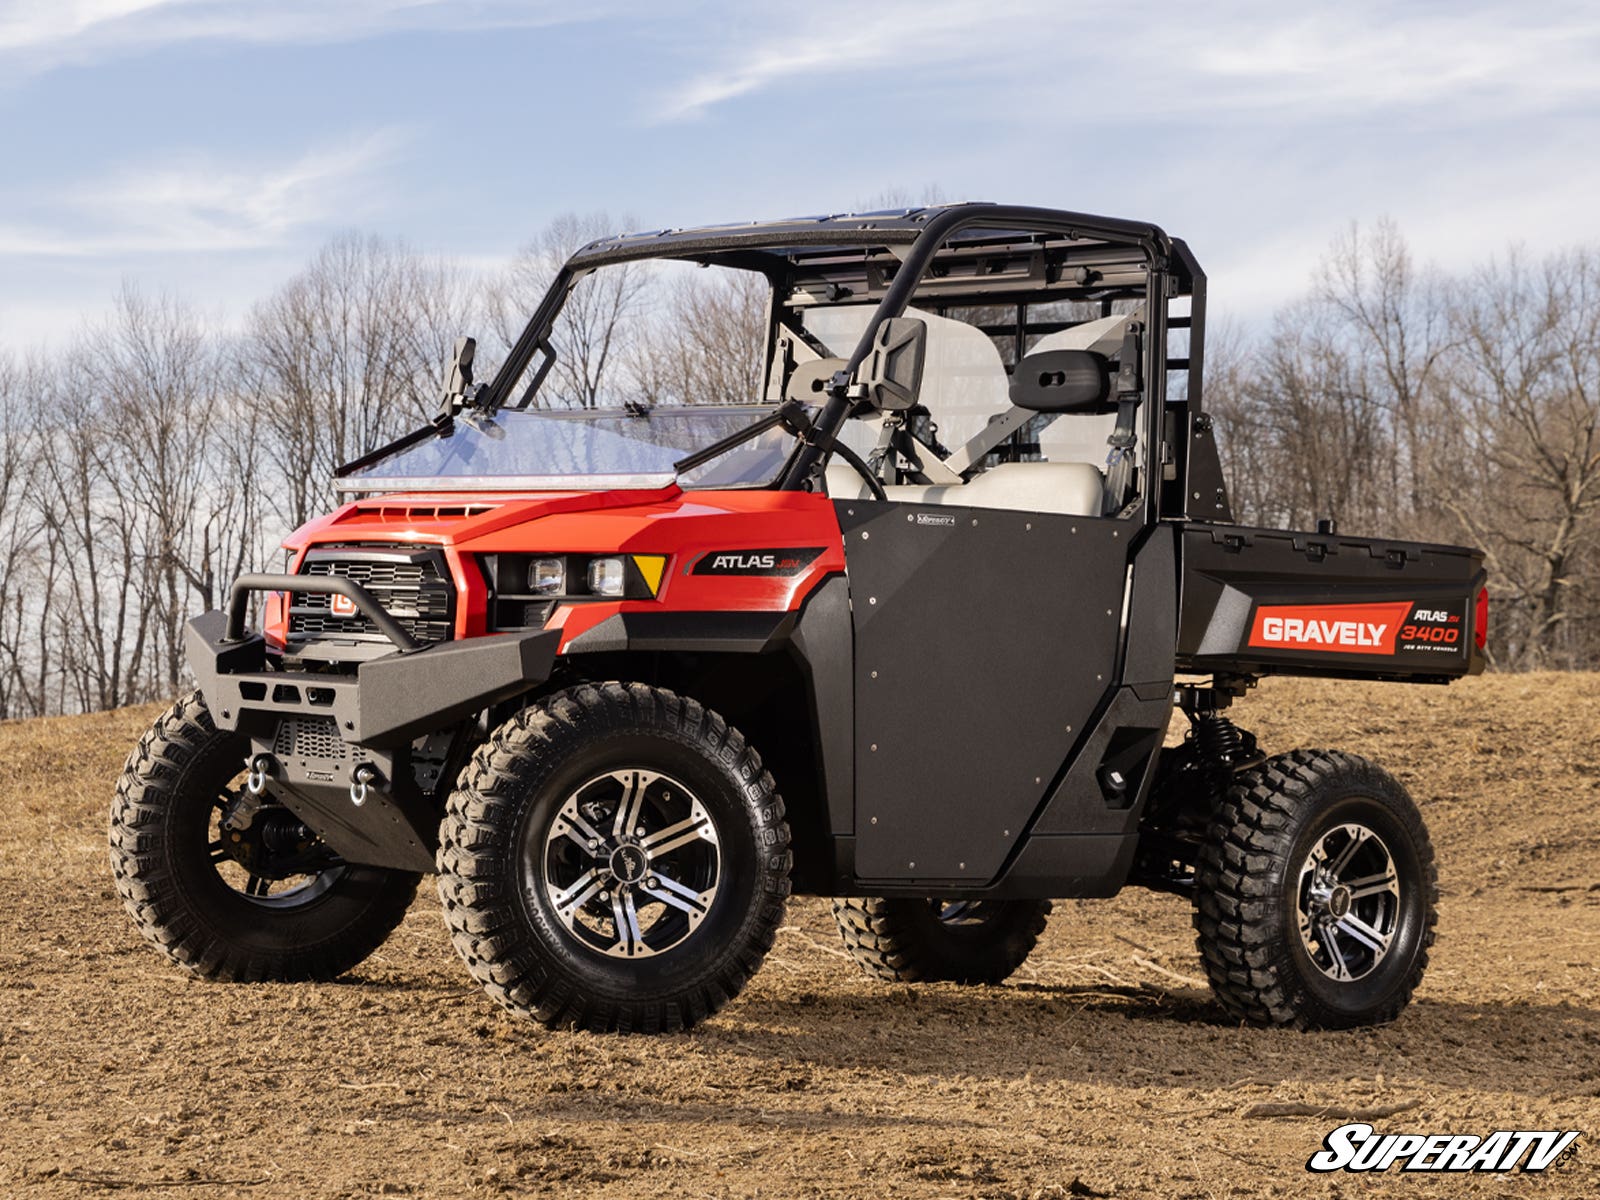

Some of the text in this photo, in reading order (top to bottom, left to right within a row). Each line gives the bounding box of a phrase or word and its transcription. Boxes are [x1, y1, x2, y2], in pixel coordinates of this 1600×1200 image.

[712, 555, 775, 569] ATLAS
[1413, 609, 1448, 622] ATLAS
[1263, 617, 1387, 646] GRAVELY
[1401, 625, 1459, 643] 3400
